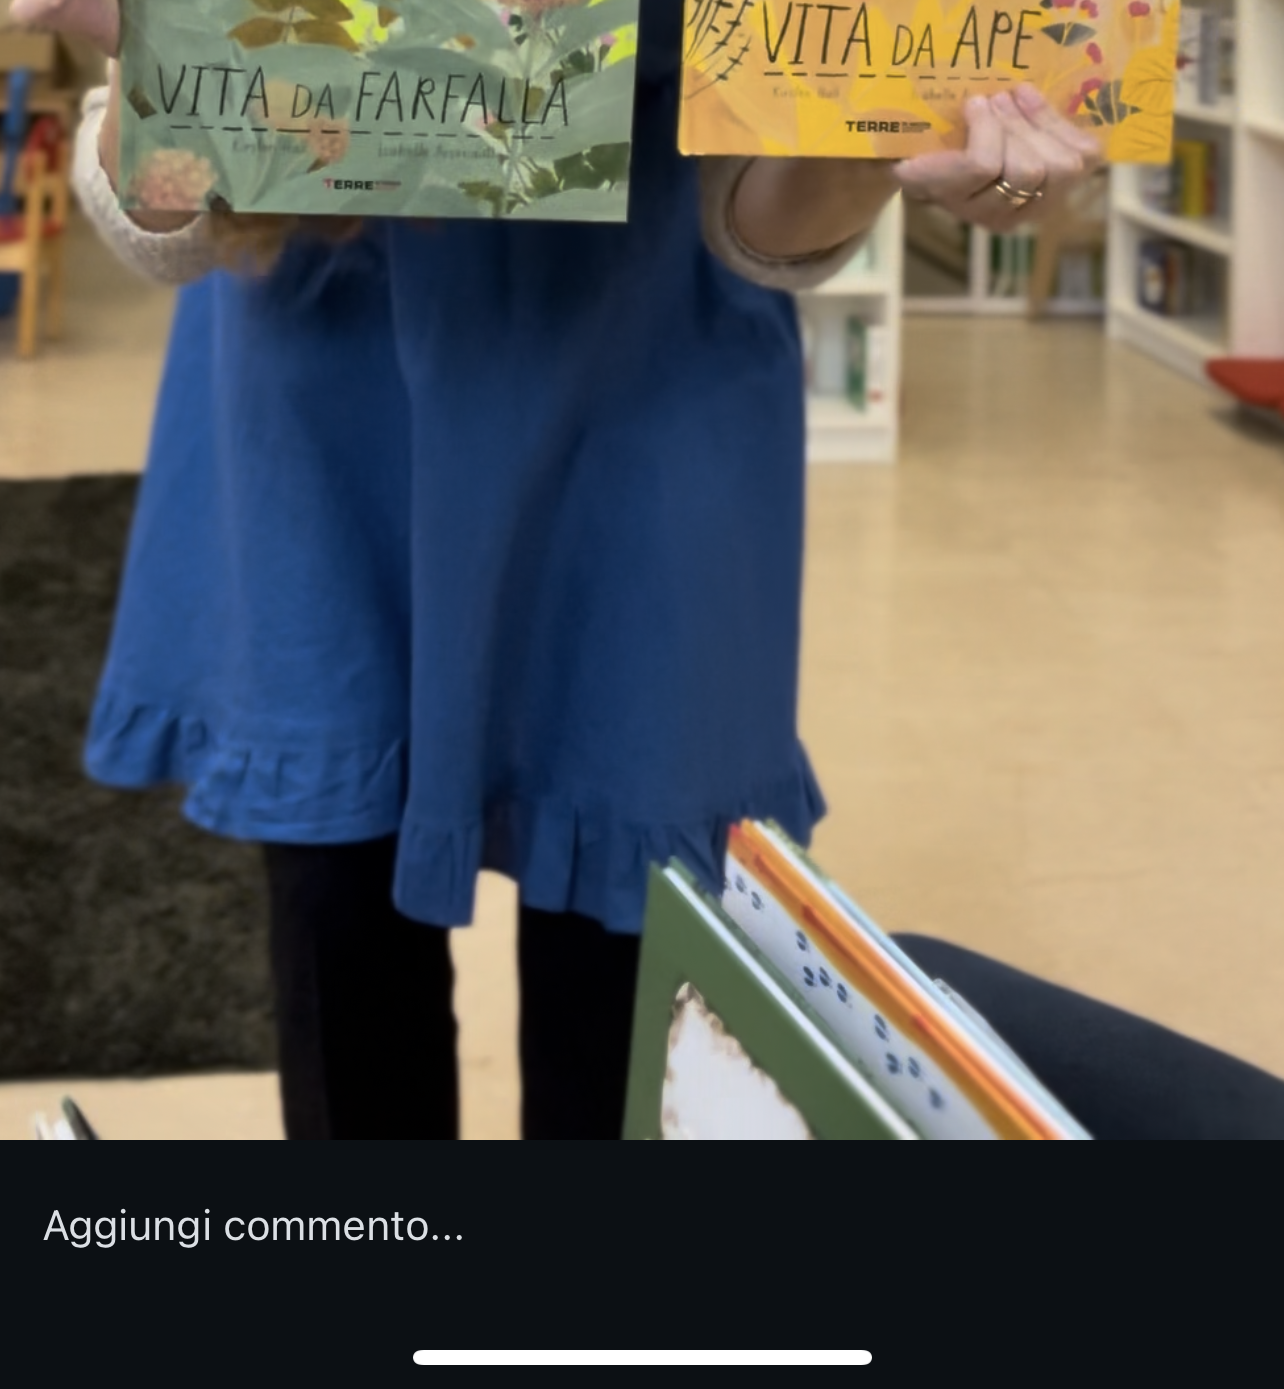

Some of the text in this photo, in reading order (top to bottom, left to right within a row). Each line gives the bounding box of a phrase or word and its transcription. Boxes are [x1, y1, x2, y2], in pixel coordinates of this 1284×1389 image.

[758, 0, 1042, 71] VITA DA APE
[157, 64, 569, 126] VITA DA FARFALLA
[845, 120, 900, 133] TERRE
[324, 178, 374, 190] TERRE
